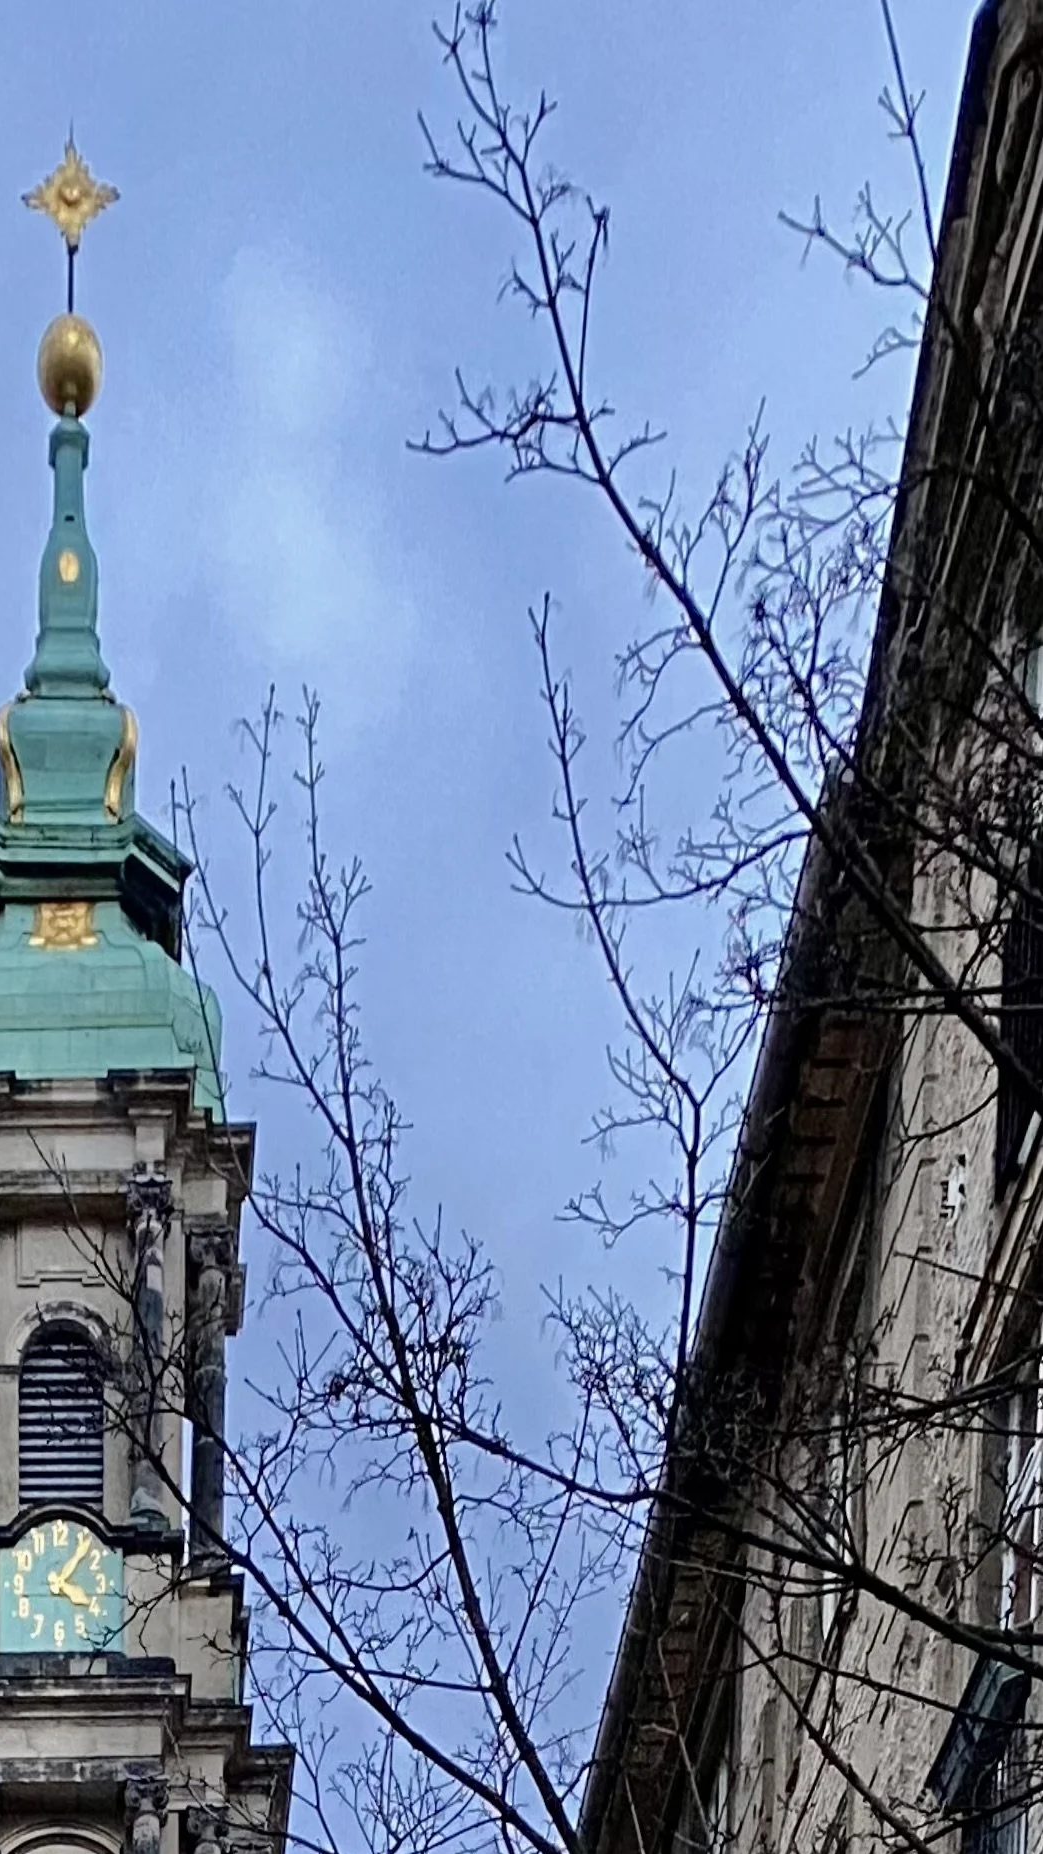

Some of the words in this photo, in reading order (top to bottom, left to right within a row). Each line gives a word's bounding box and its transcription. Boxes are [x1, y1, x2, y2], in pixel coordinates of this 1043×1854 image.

[33, 1532, 45, 1555] 11
[52, 1524, 68, 1547] 12
[17, 1550, 32, 1572] 10
[89, 1549, 101, 1570] 2
[14, 1574, 24, 1595] 9
[96, 1573, 106, 1594] 3
[19, 1597, 29, 1618] 8
[89, 1596, 100, 1617] 4
[33, 1614, 44, 1636] 7
[54, 1620, 64, 1641] 6
[74, 1614, 85, 1634] 5
